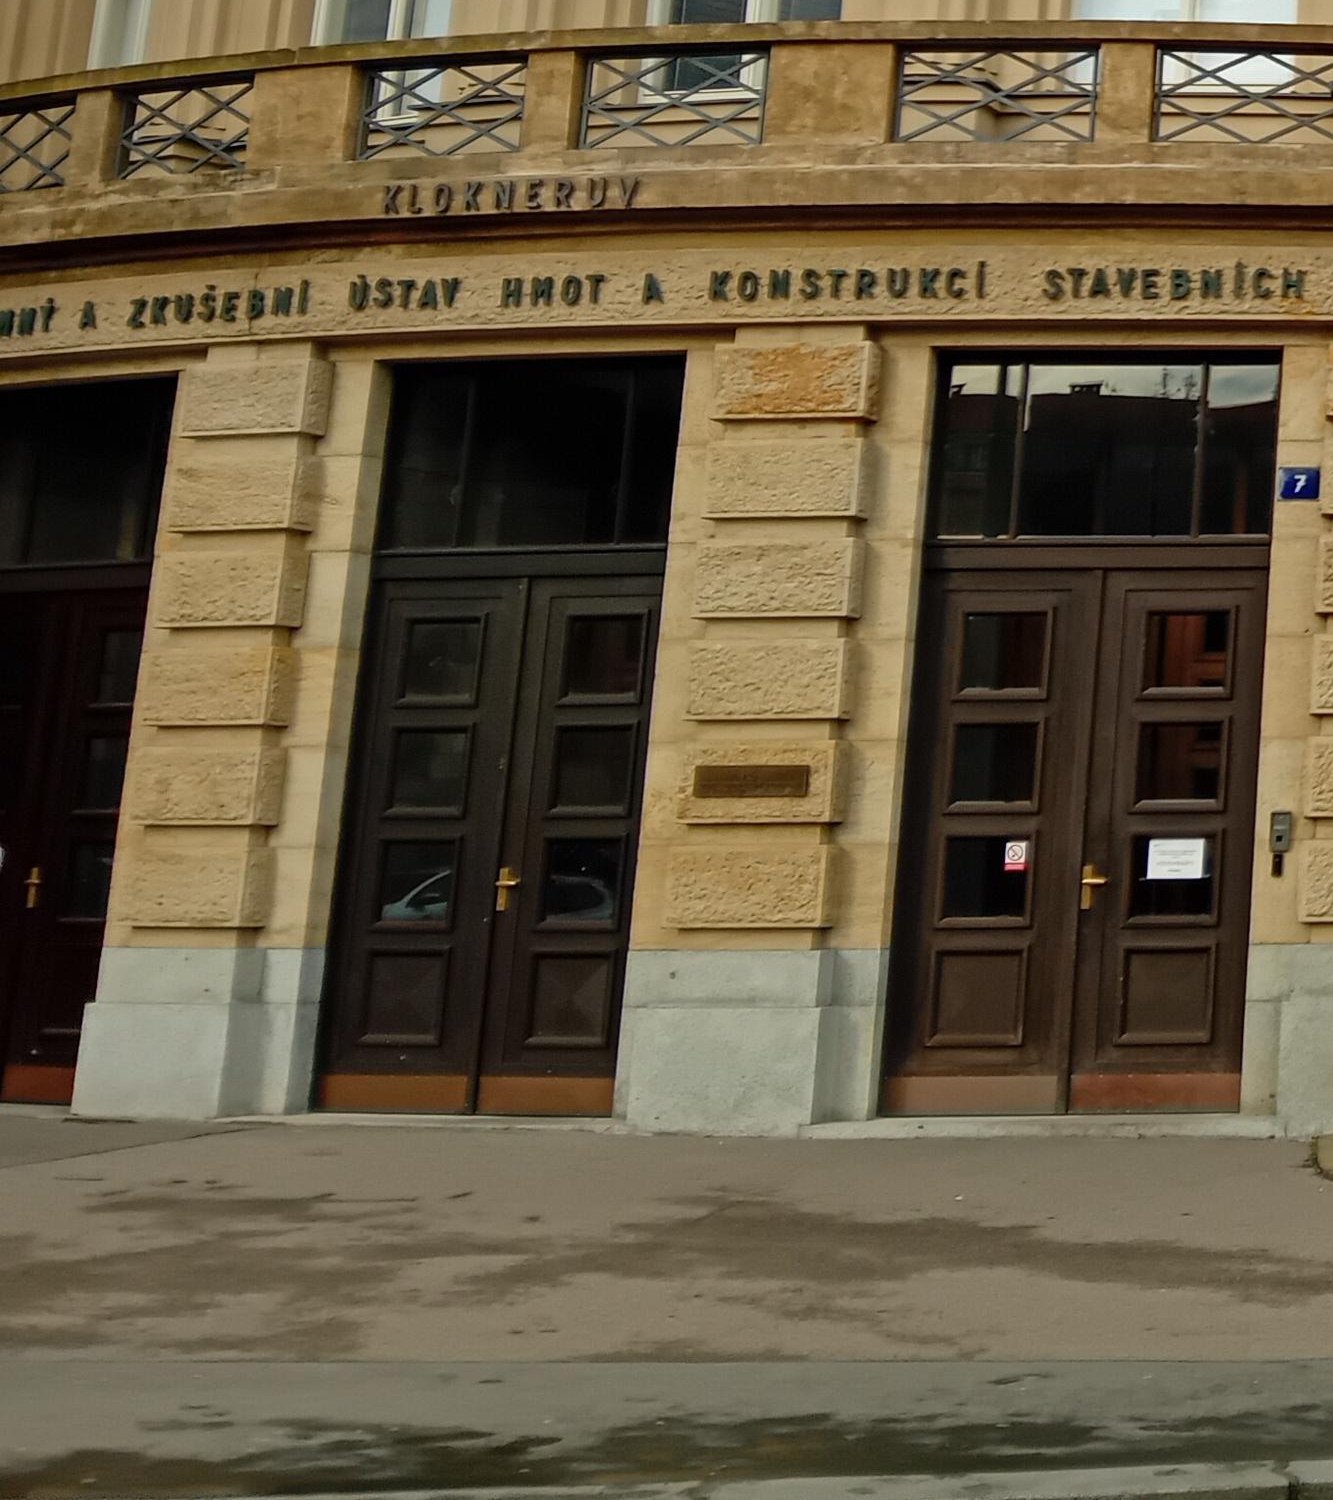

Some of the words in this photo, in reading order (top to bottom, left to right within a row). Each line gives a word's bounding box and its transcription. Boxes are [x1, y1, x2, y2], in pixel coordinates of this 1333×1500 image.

[79, 301, 97, 332] A
[126, 279, 310, 329] ZKUŠEBNÍ
[349, 274, 463, 312] ÚSTAV
[502, 274, 606, 308] HMOT
[642, 273, 664, 305] A
[708, 260, 986, 303] KONSTRUKCÍ
[1042, 261, 1307, 301] STAVEBNÍCH
[1294, 474, 1307, 494] 7
